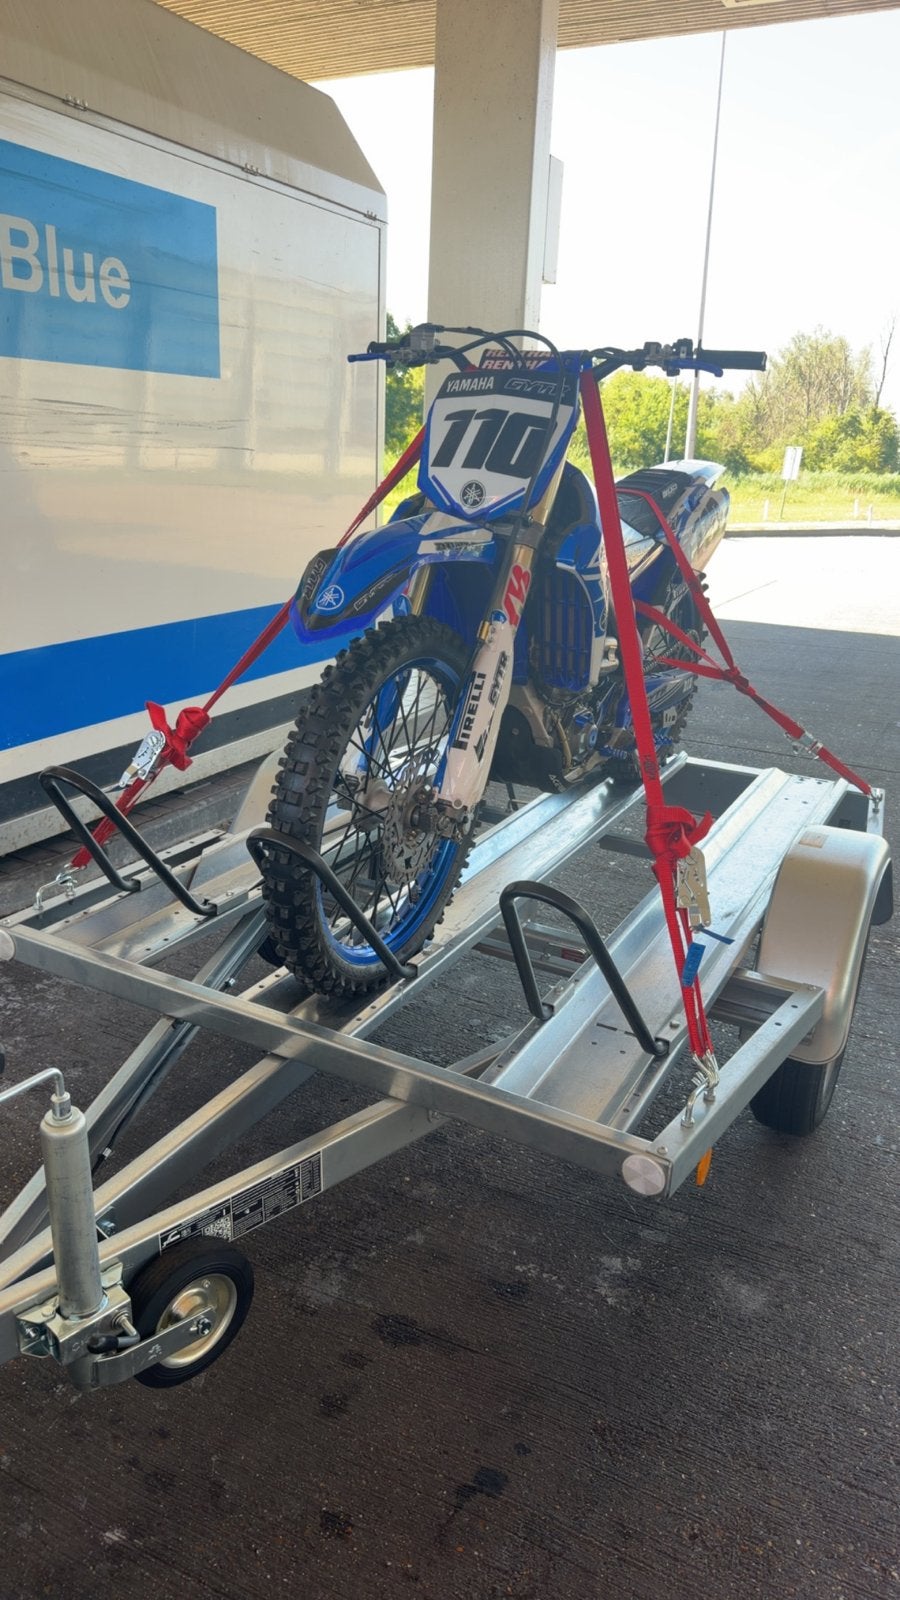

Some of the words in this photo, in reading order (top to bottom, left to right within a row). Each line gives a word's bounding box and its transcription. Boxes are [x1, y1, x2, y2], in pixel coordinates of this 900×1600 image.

[0, 213, 131, 309] Blue
[447, 376, 494, 393] YAMAHA
[430, 408, 558, 480] 110
[452, 670, 487, 751] PIRELLI
